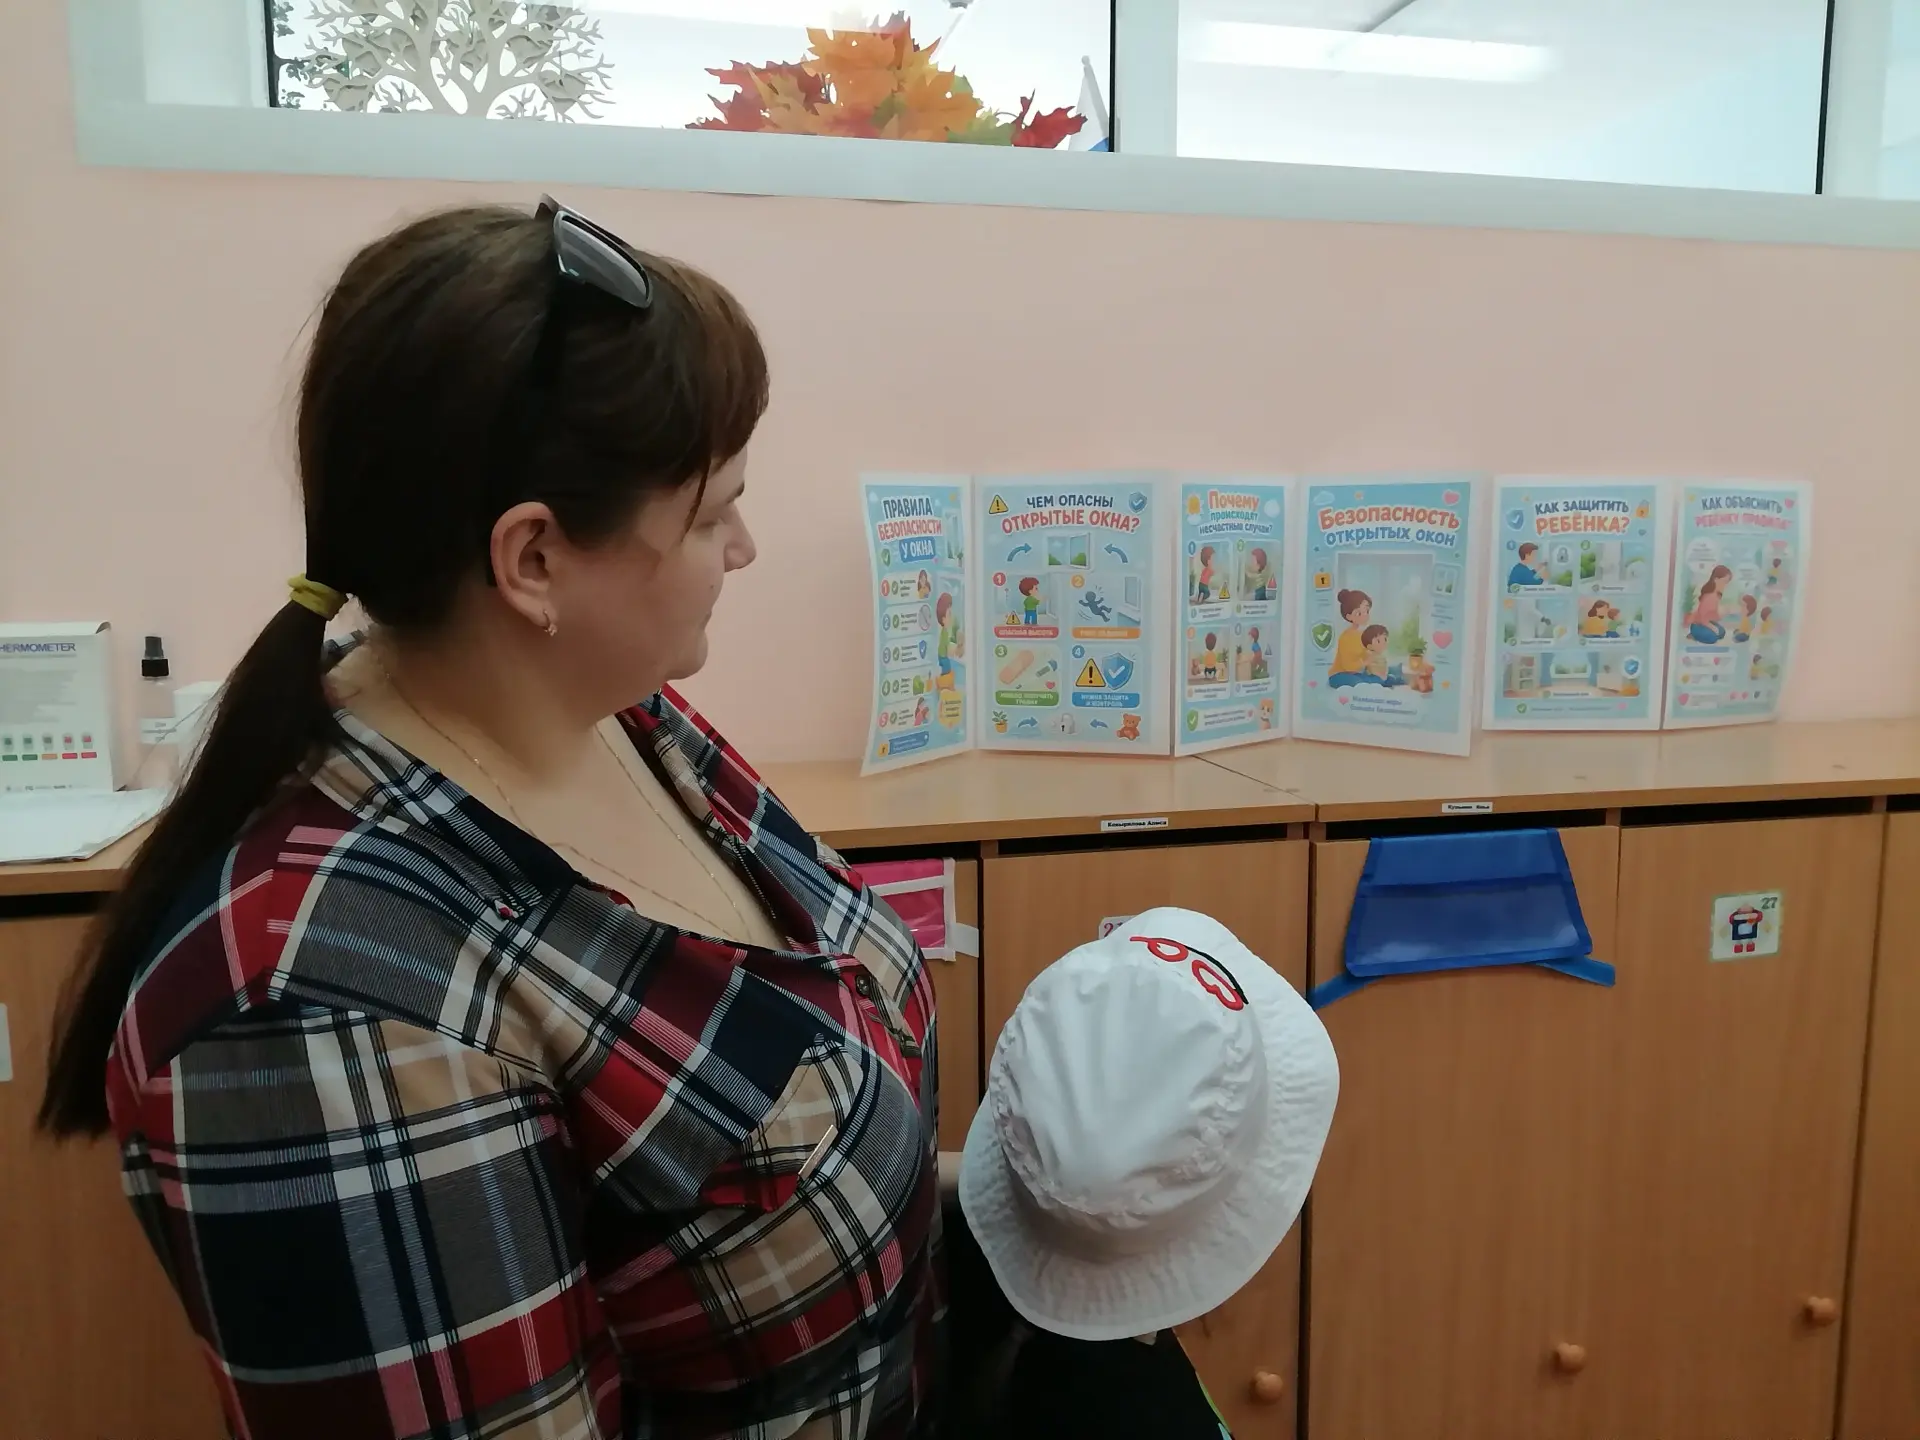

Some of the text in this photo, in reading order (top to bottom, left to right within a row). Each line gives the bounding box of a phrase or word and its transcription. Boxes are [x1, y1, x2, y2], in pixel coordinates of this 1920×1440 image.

[883, 497, 933, 519] ПРАВИЛА
[1026, 494, 1114, 508] ЧЕМ ОПАСНЫ
[1208, 490, 1259, 511] Почему
[1535, 499, 1629, 515] КАК ЗАЩИТИТЬ
[1701, 496, 1722, 511] КАК
[1001, 509, 1140, 534] ОТКРЫТЫЕ ОКНА?
[1318, 506, 1460, 530] Безопасность
[1536, 513, 1630, 535] РЕБЁНКА?
[878, 519, 942, 541] БЕЗОПАСНОСТИ
[1326, 526, 1456, 546] открытых окон
[901, 540, 934, 559] У ОКНА
[1761, 896, 1778, 909] 27
